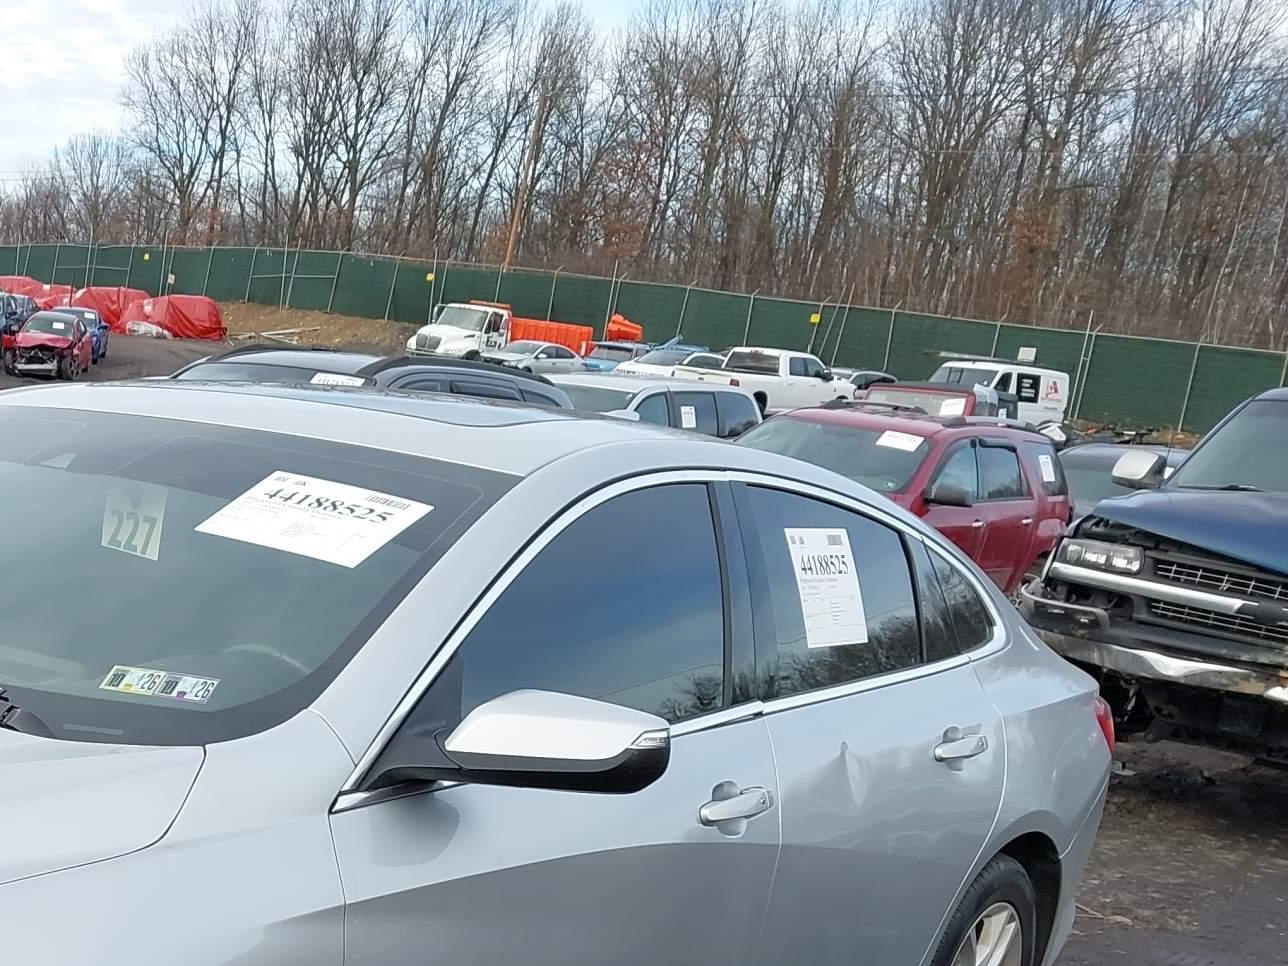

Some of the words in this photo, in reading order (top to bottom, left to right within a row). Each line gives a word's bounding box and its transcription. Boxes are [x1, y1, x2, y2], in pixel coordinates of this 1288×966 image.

[264, 488, 395, 523] 44188525
[107, 508, 158, 555] 227
[800, 555, 849, 575] 44188525
